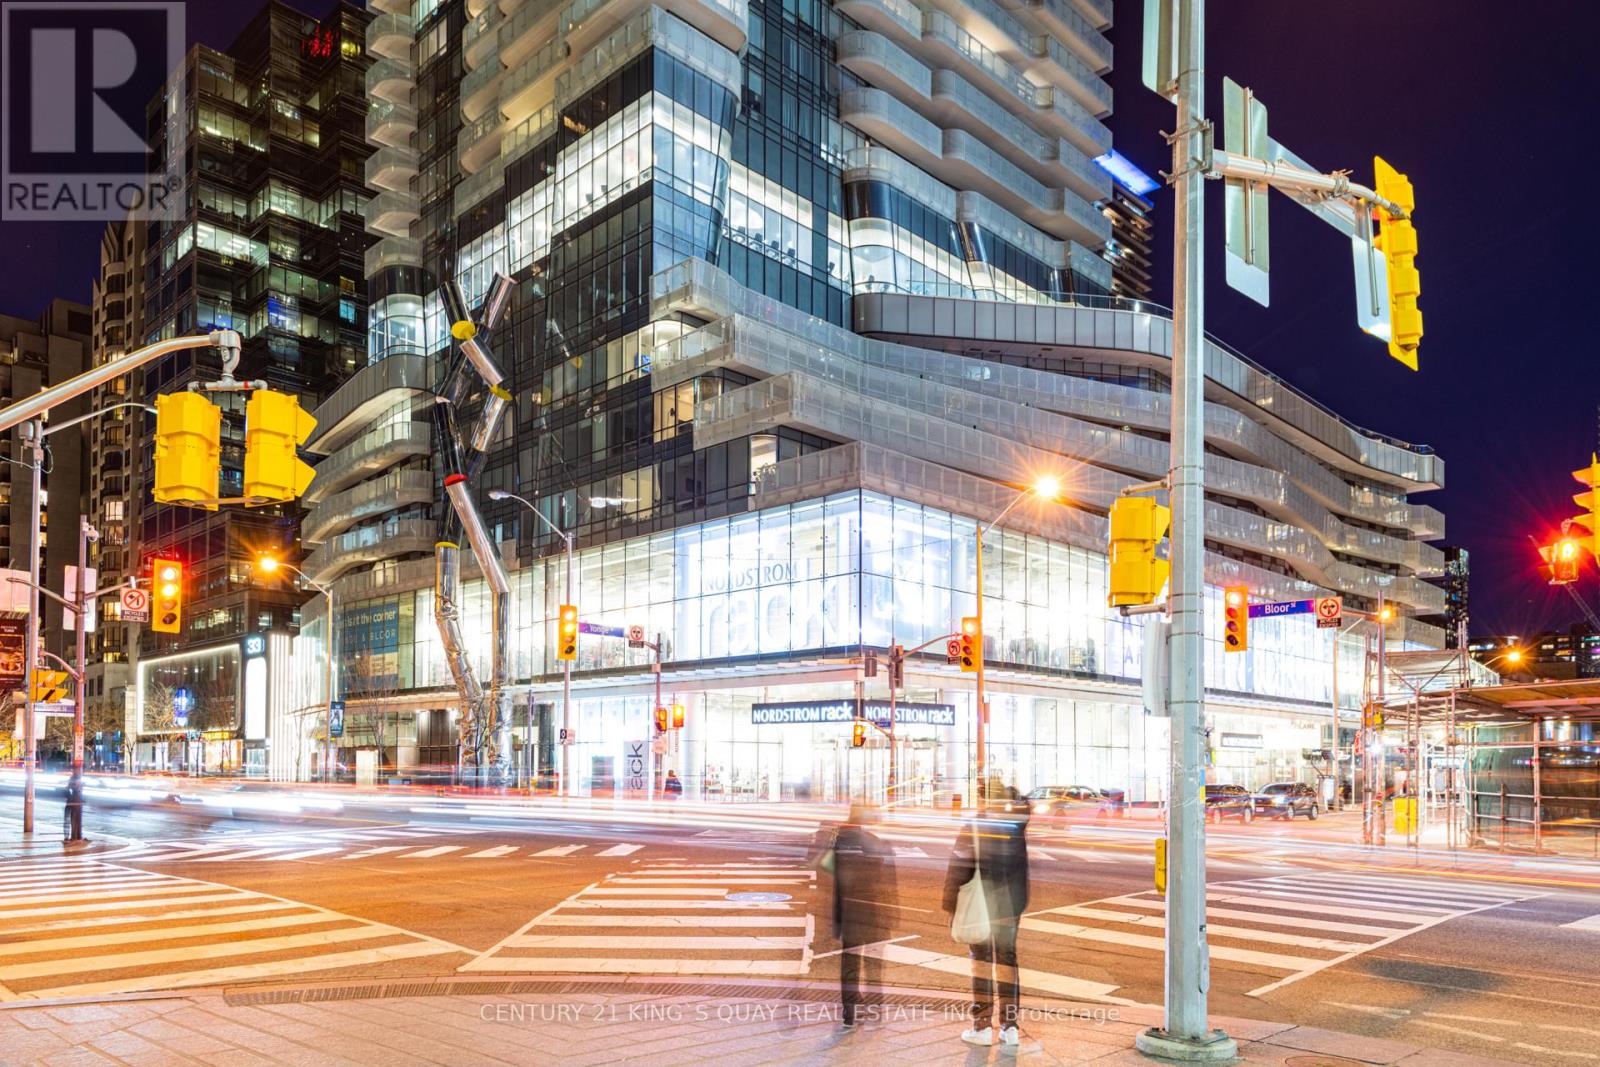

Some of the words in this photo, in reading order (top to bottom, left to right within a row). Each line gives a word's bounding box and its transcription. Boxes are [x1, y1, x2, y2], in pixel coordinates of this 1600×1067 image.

[1264, 604, 1290, 614] Bloor
[247, 637, 262, 654] 33
[753, 704, 819, 723] NORDSTROM
[821, 701, 853, 720] rack
[928, 706, 953, 724] rack
